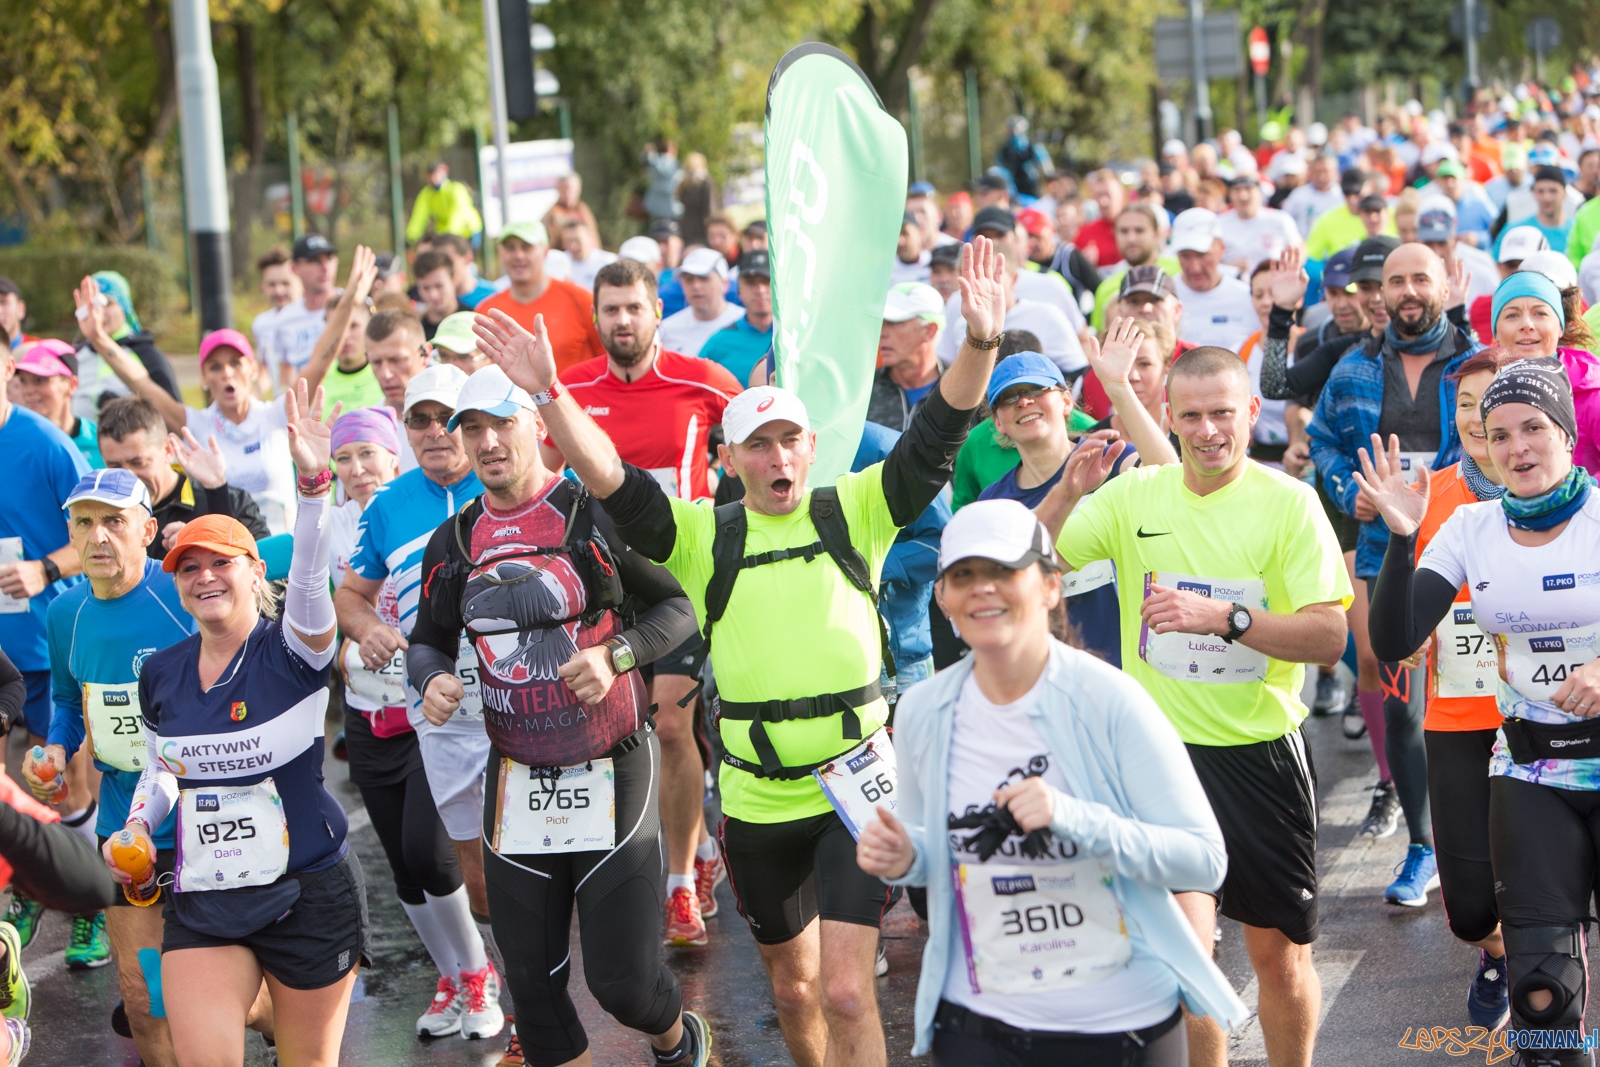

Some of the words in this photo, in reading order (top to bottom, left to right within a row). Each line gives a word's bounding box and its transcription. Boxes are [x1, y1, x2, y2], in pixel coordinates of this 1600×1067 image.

[1475, 581, 1490, 591] 4F
[1545, 578, 1573, 587] 17.PKO
[1214, 593, 1244, 601] maraton
[1495, 611, 1530, 624] SIŁA
[1188, 641, 1227, 653] Łukasz
[1532, 640, 1562, 649] 17.PKO
[1212, 667, 1226, 675] 4F
[104, 694, 127, 704] 17.PKO
[481, 681, 515, 715] KRUK
[518, 681, 583, 715] TEAM
[181, 736, 262, 758] AKTYWNY
[198, 752, 274, 774] STĘSZEW
[850, 752, 875, 768] 17.PKO
[197, 798, 217, 808] 17.PKO
[528, 787, 591, 811] 6765
[545, 815, 570, 825] Piotr
[197, 816, 257, 845] 1925
[563, 837, 576, 845] 4F
[214, 847, 243, 859] Daria
[237, 870, 250, 879] 4F
[1000, 902, 1084, 937] 3610
[1020, 937, 1076, 955] Karolina
